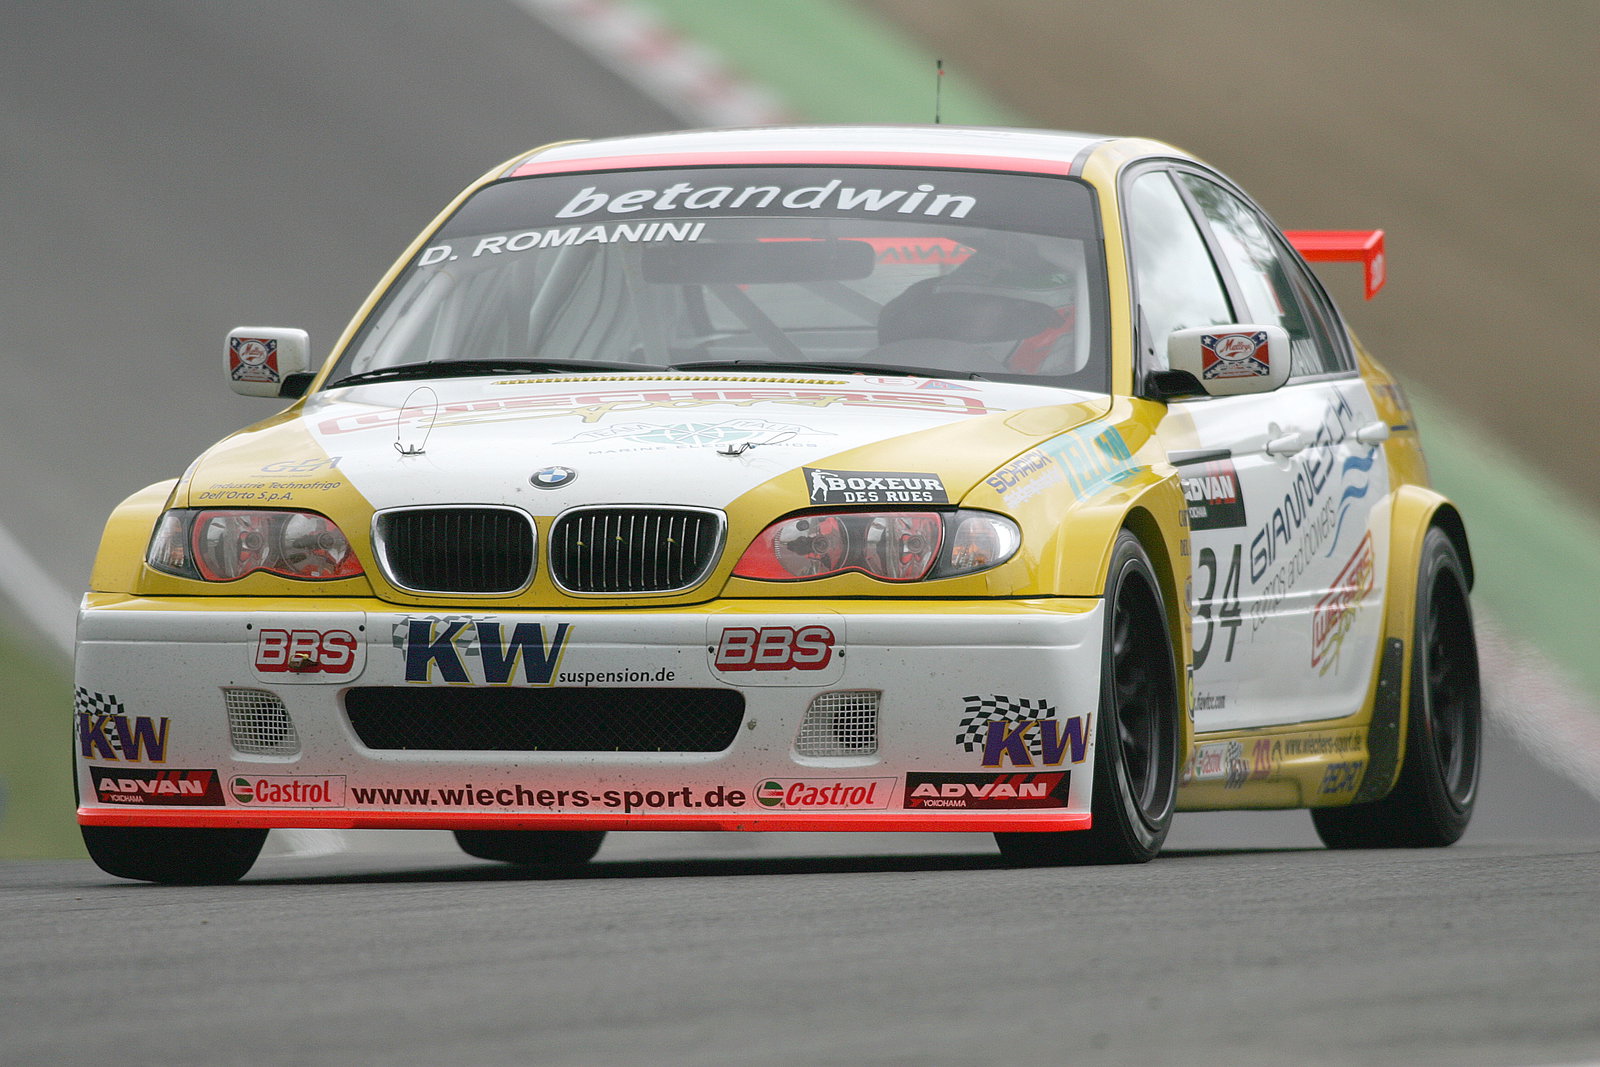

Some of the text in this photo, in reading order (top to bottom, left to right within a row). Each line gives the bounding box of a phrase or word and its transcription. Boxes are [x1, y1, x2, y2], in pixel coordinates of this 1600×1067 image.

[555, 179, 977, 220] betandwin
[418, 222, 706, 267] D. ROMANINI
[199, 491, 294, 502] Dell'Orto S.p.A.
[209, 480, 342, 492] Industrie Technofrigo
[825, 477, 945, 491] BOXEUR
[843, 491, 934, 503] DES RUES
[255, 628, 358, 674] BBS
[404, 618, 676, 687] KW suspension.de
[714, 625, 836, 672] BBS
[79, 712, 171, 764] KW
[981, 711, 1092, 768] KW
[99, 777, 204, 794] ADVAN
[255, 779, 332, 803] Castrol
[350, 784, 747, 813] www.wiechers-sport.de
[784, 781, 877, 807] Castrol
[910, 782, 1048, 799] ADVAN
[922, 799, 967, 808] YOKOHAMA
